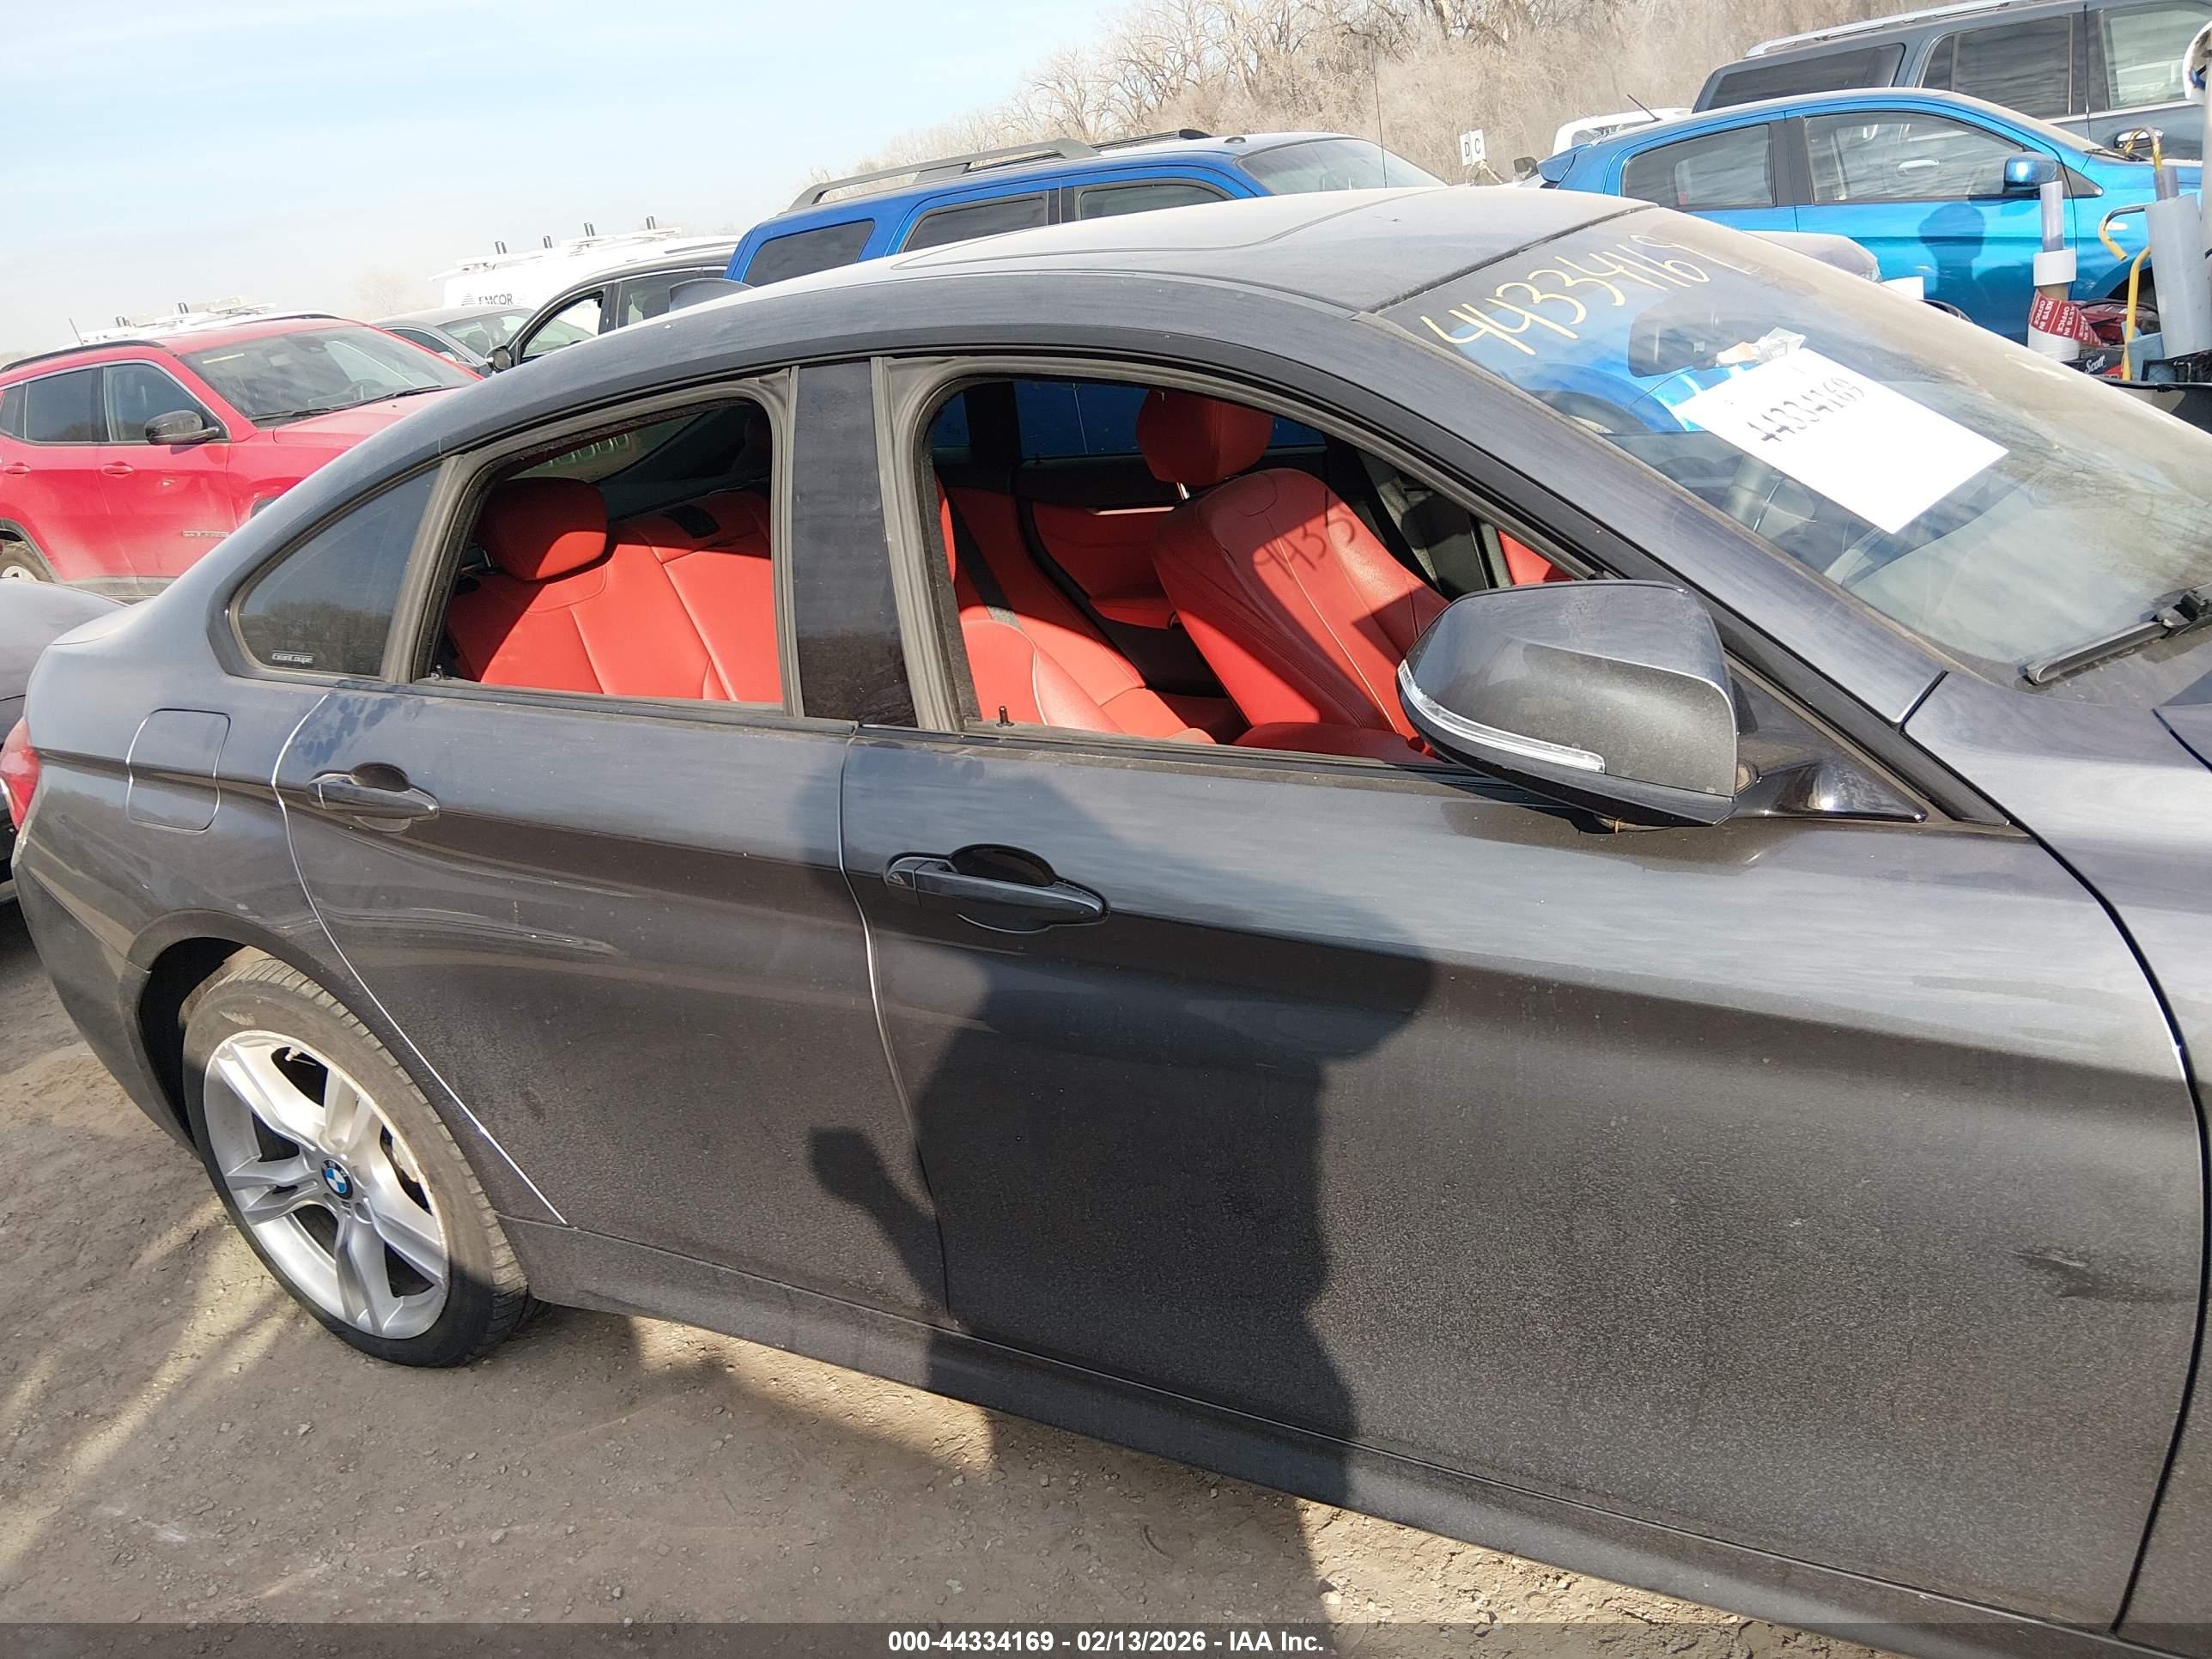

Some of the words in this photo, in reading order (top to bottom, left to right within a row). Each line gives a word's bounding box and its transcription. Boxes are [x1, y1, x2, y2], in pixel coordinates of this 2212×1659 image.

[1464, 141, 1471, 157] D
[1474, 137, 1481, 154] C
[477, 293, 514, 306] EMCOR
[1419, 234, 1753, 356] 44334169
[2033, 300, 2045, 325] OFFICE
[2042, 301, 2055, 320] KEYS
[2057, 306, 2070, 332] OFFICE
[2039, 321, 2046, 330] IN
[2063, 327, 2070, 336] IN
[1746, 377, 1865, 442] 44334169
